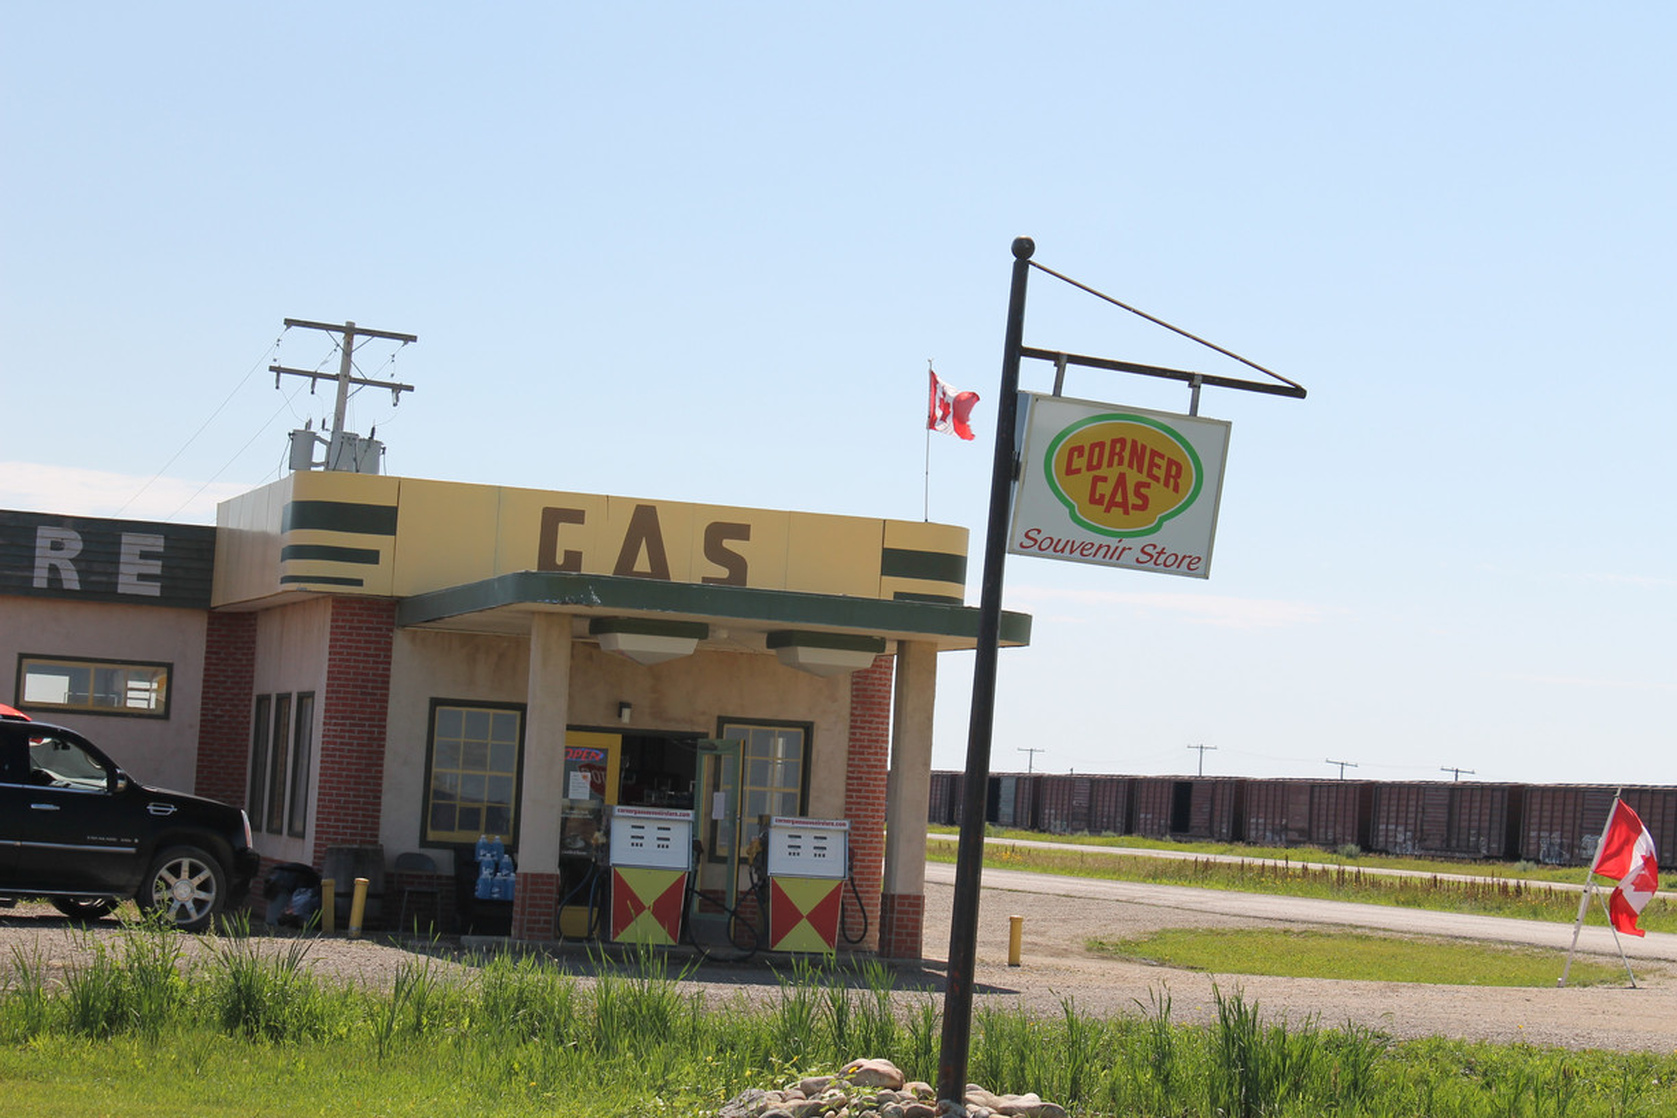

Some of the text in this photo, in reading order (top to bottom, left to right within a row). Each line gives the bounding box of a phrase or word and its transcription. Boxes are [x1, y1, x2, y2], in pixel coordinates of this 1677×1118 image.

[1065, 437, 1183, 494] CORNER
[1088, 472, 1151, 516] GAS
[537, 504, 751, 587] GAS
[1019, 528, 1203, 572] Souvenir Store
